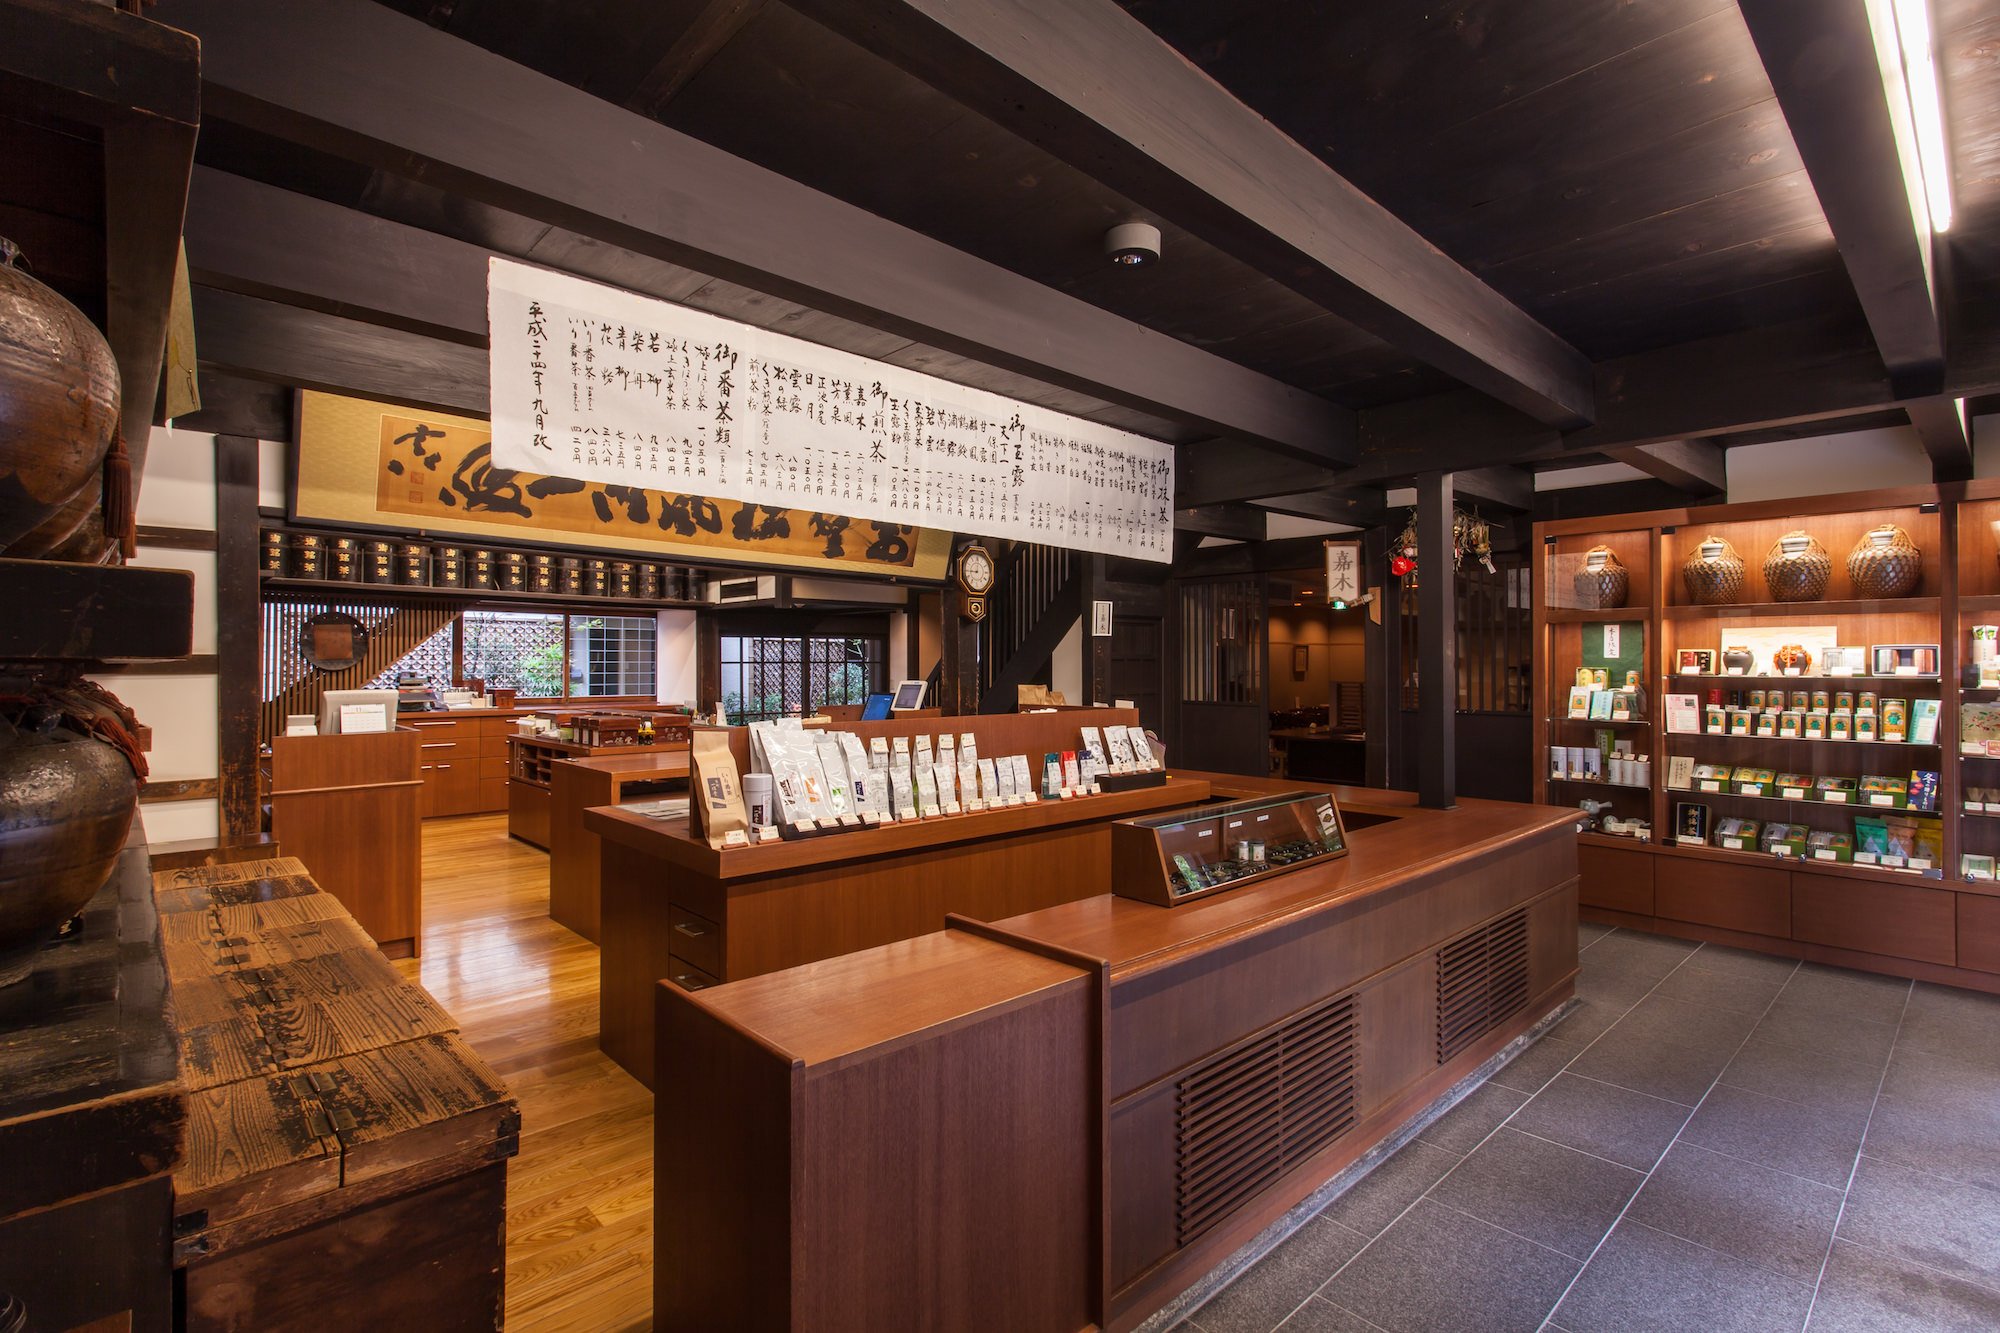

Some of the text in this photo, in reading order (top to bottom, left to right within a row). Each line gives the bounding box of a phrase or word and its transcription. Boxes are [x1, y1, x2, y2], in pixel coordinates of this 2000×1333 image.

[528, 302, 552, 450] 平成二十四年九月改
[569, 317, 581, 377] いり番茶
[583, 319, 595, 380] いり番茶
[615, 326, 629, 391] 青柳
[647, 332, 662, 397] 若柳
[664, 338, 677, 410] 極上玄米茶
[682, 341, 691, 411] くきほうじ茶
[695, 345, 709, 411] 極上ほうじ茶
[806, 373, 814, 419] 日月
[831, 379, 842, 424] 芳泉
[854, 385, 867, 431] 嘉木
[870, 381, 888, 463] 御煎茶
[999, 425, 1009, 463] 天下一
[1009, 413, 1025, 488] 御玉露
[1157, 458, 1170, 525] 御抹茶
[1332, 550, 1355, 592] 嘉木
[605, 736, 633, 745] 一保堂
